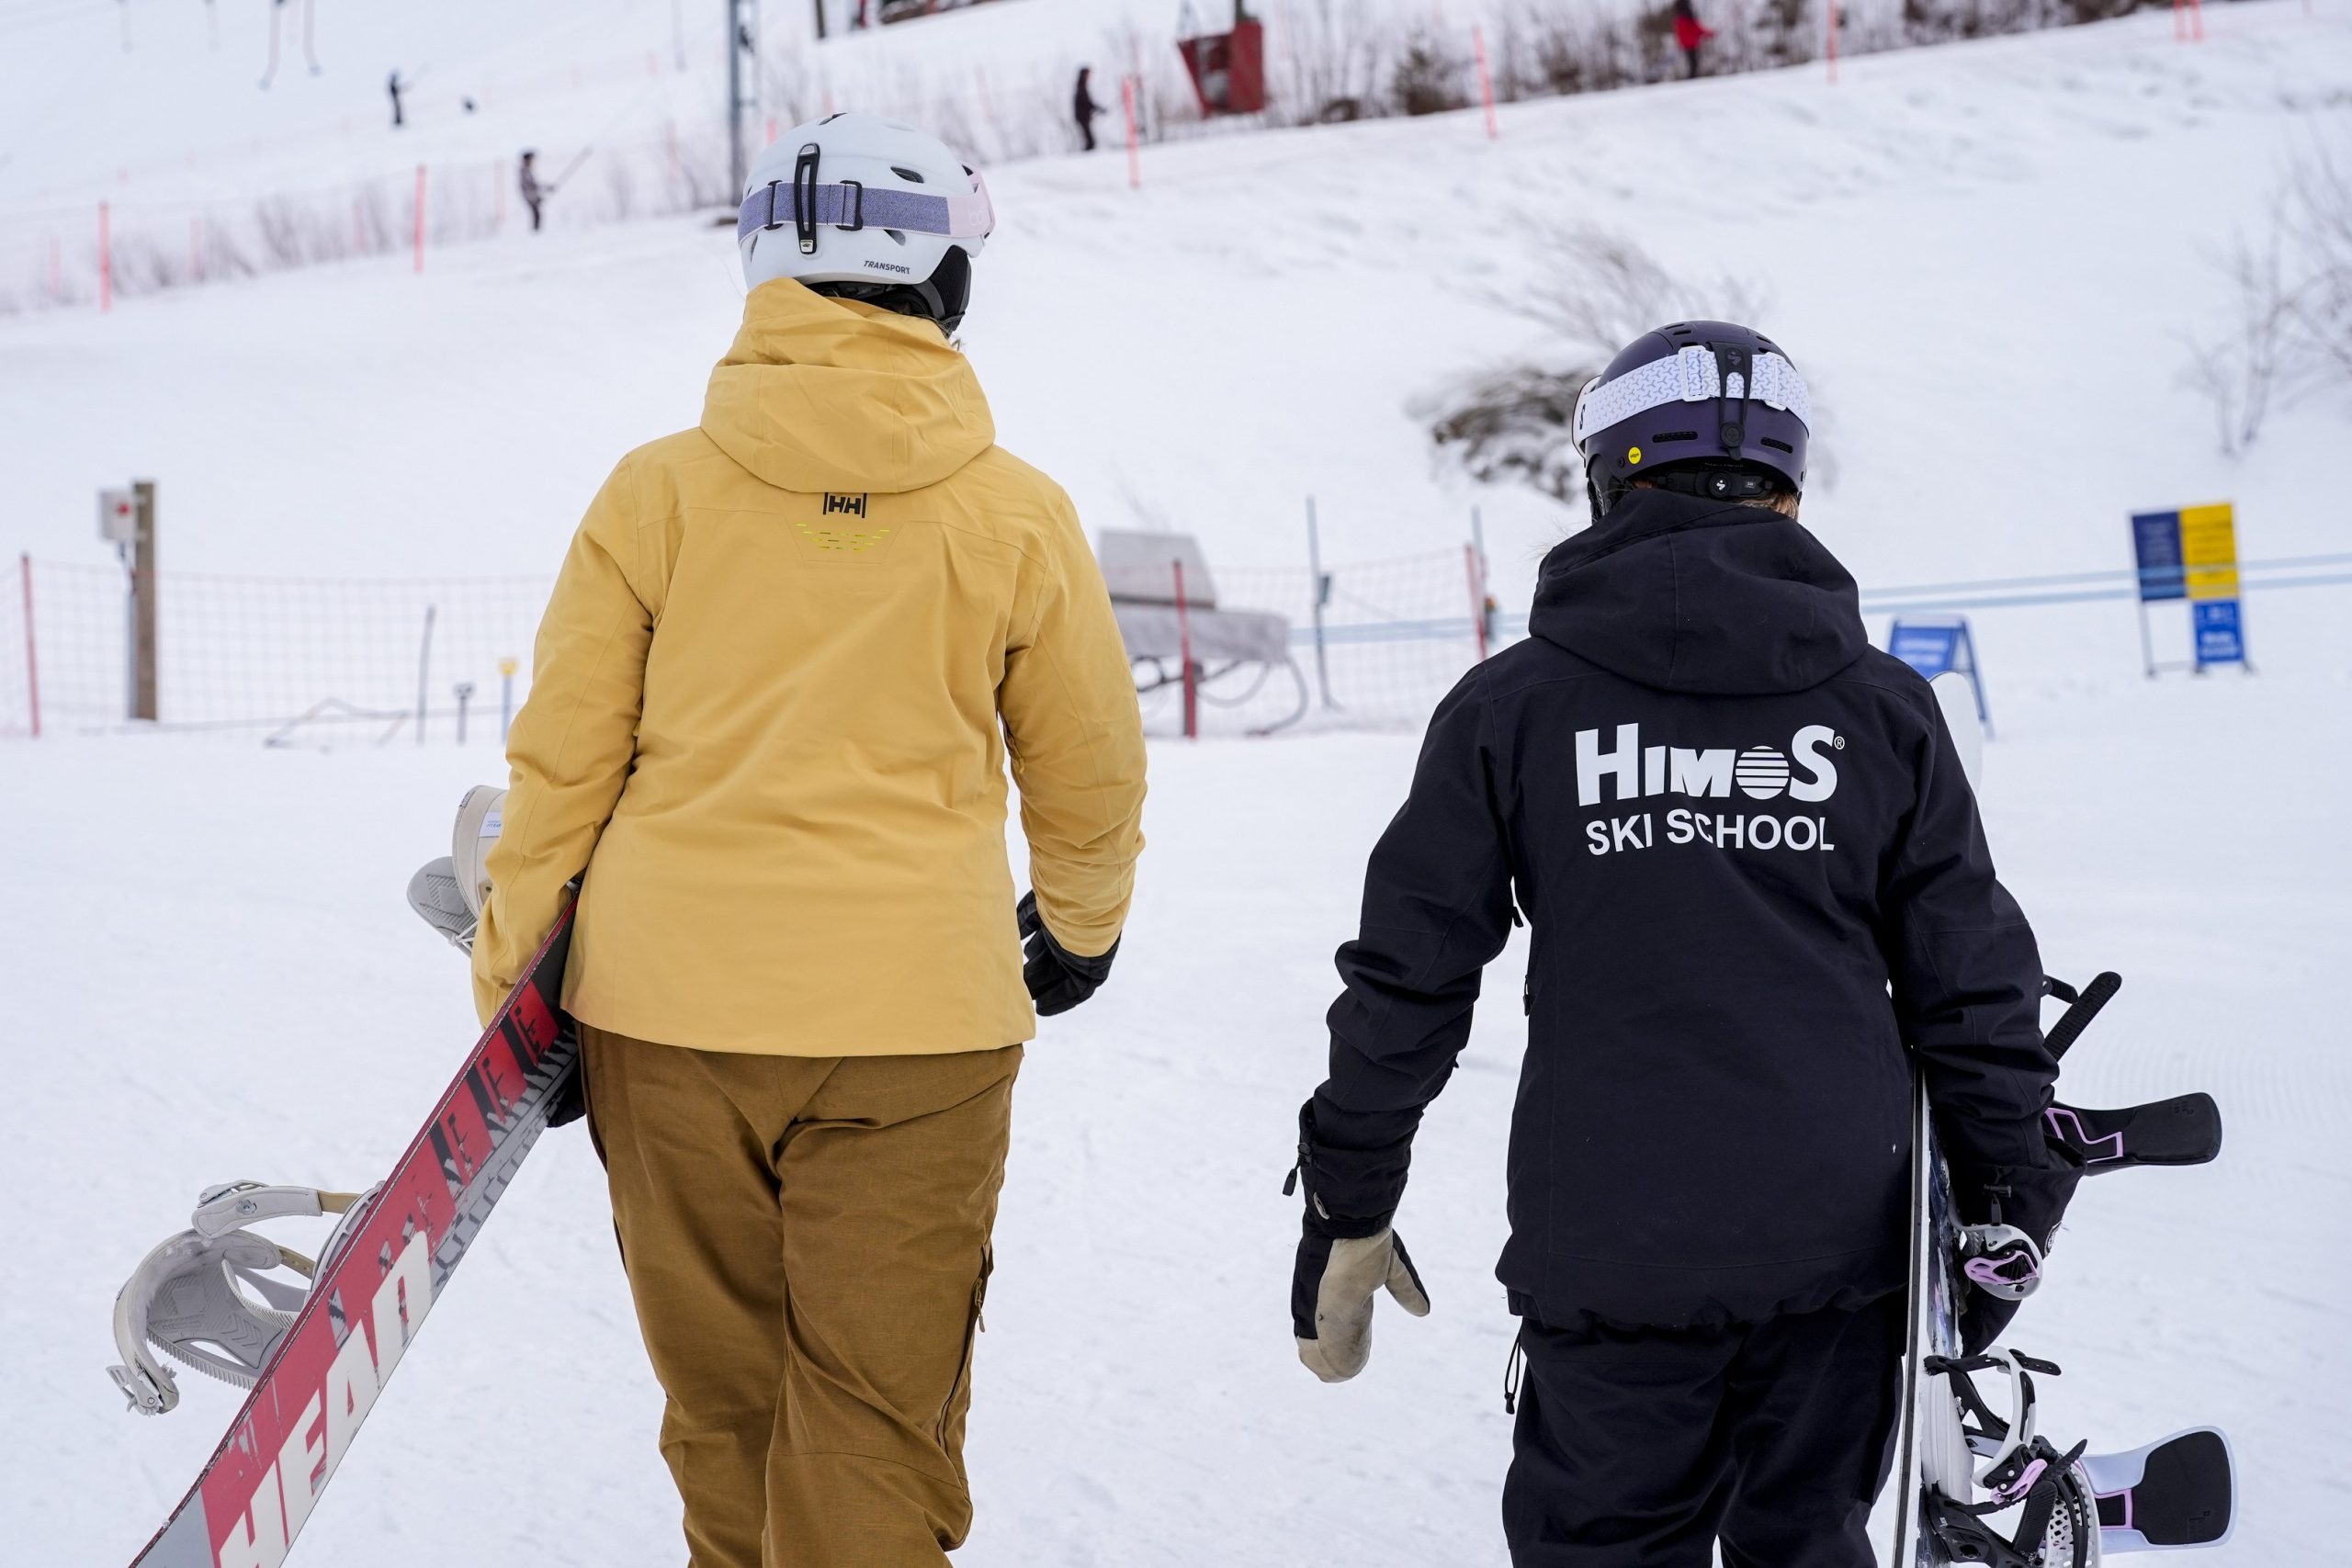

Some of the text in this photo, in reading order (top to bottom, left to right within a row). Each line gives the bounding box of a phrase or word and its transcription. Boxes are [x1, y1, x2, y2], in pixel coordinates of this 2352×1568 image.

[864, 260, 910, 275] TRANSPORT
[1586, 808, 1835, 855] SKI SCHOOL
